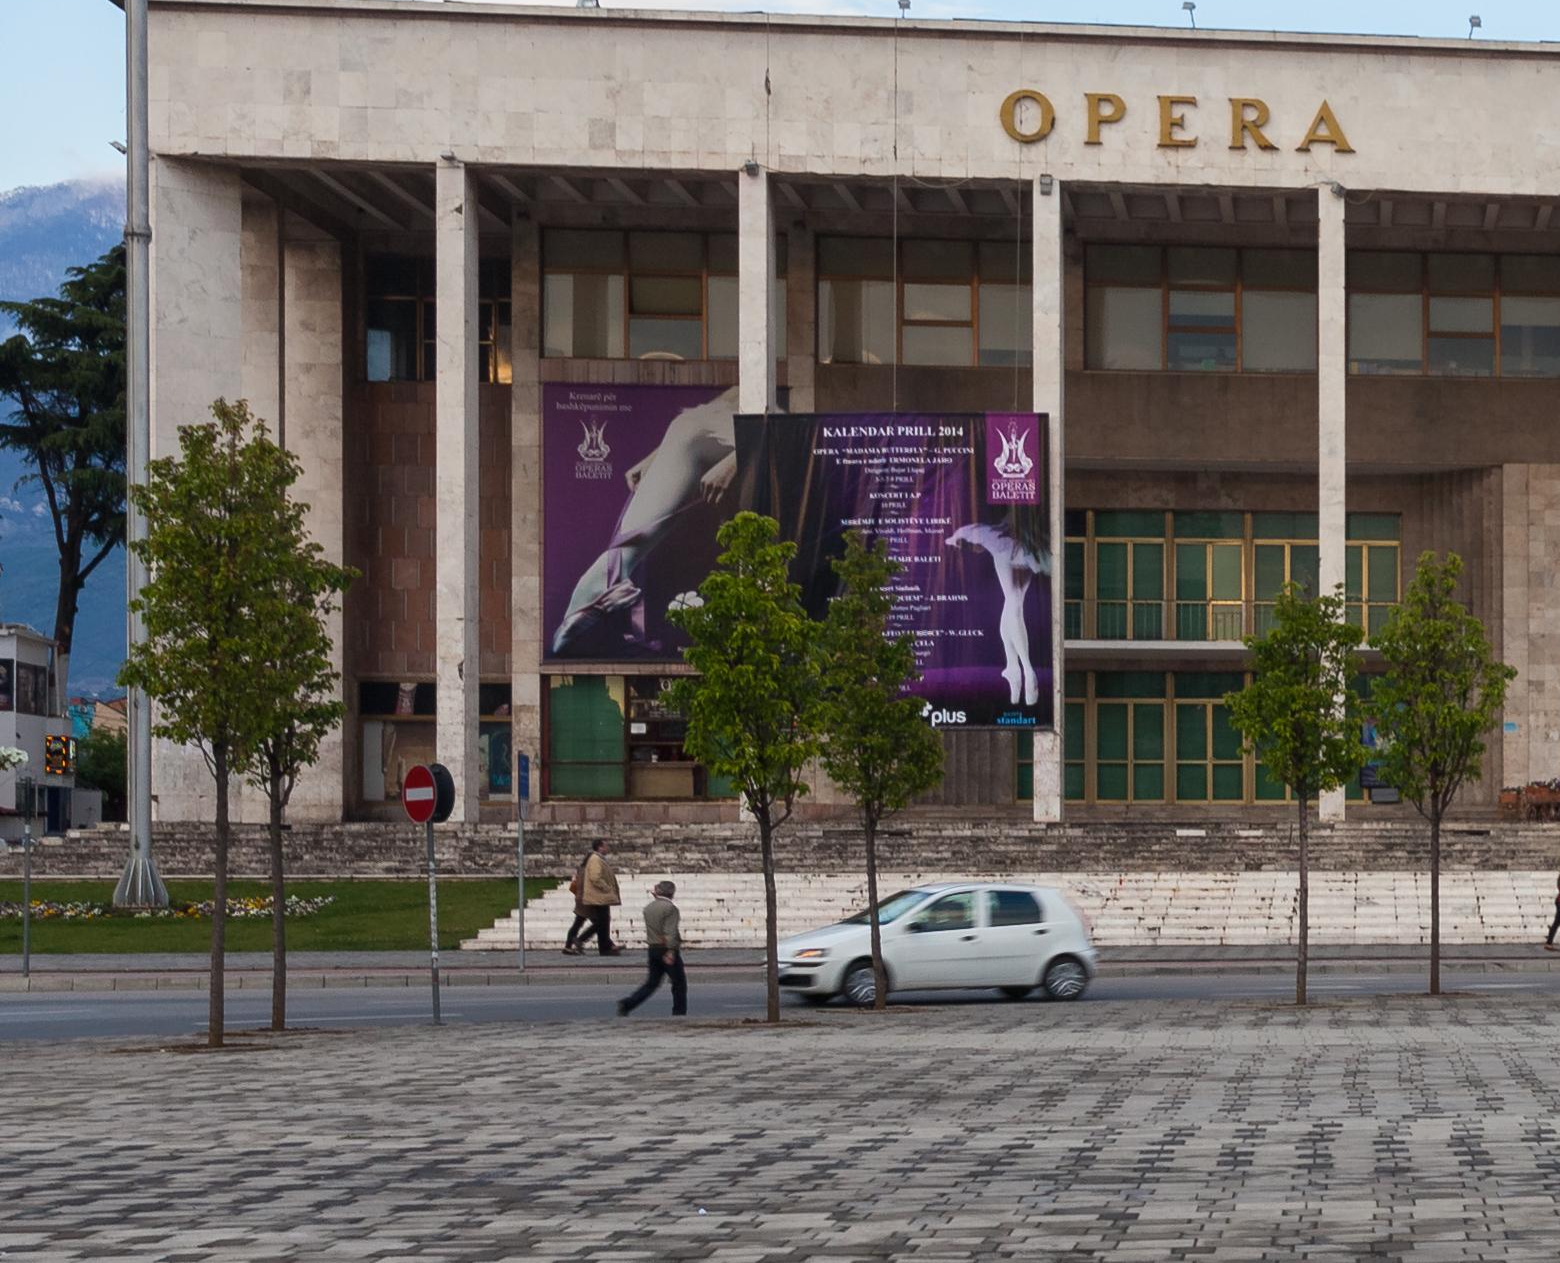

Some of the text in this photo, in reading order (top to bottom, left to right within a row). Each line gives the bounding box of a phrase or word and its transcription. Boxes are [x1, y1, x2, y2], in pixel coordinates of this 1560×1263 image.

[1000, 89, 1355, 153] OPERA
[823, 426, 964, 438] KALENDAR PRILL 2014
[991, 482, 1036, 491] OPERAS
[992, 491, 1036, 499] BALETIT
[936, 594, 969, 602] BRAHMS
[931, 708, 967, 727] plus
